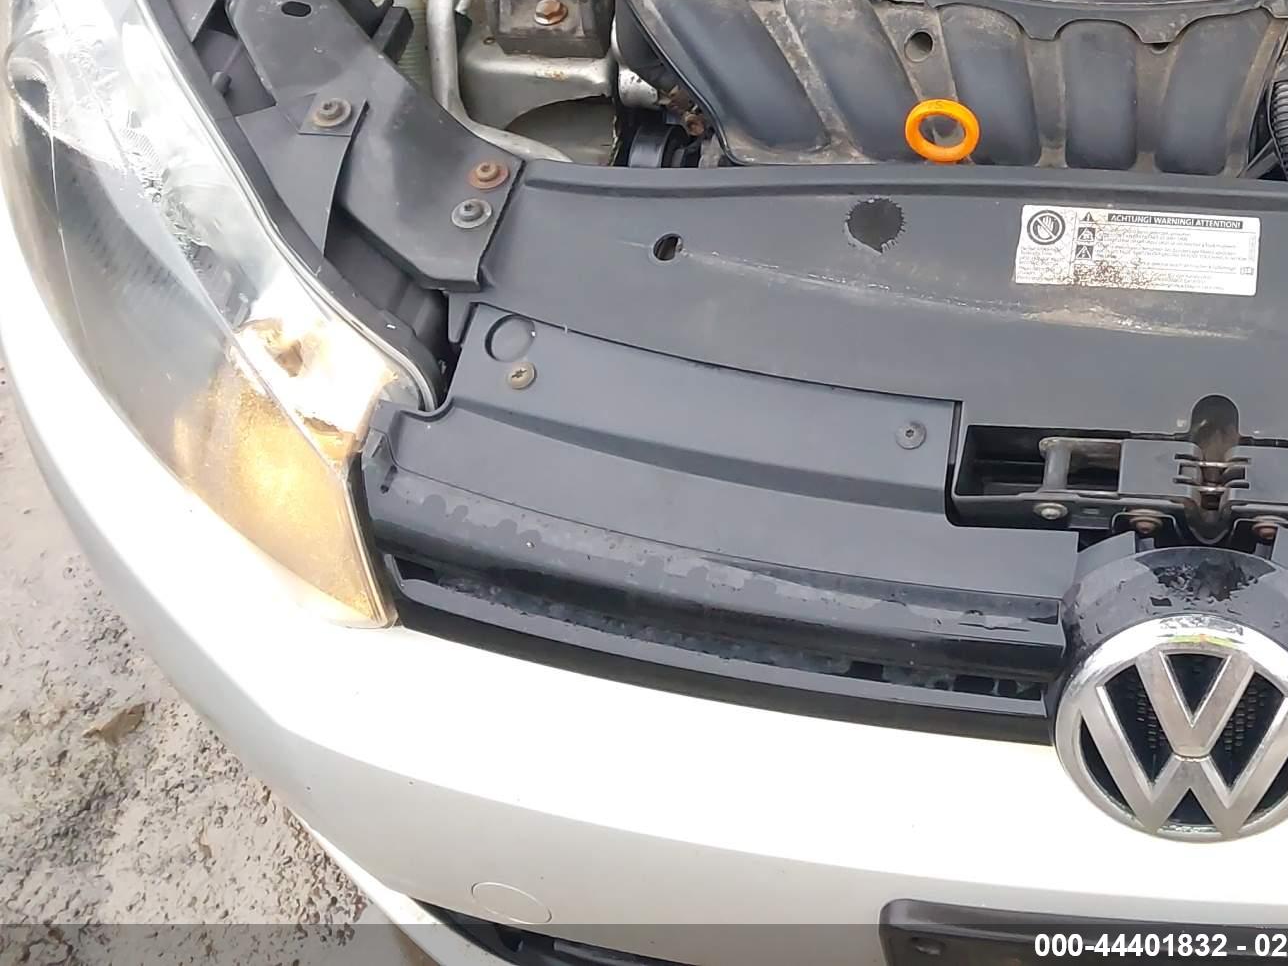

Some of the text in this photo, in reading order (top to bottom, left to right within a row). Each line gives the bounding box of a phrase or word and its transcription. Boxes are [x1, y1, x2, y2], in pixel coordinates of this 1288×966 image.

[1110, 214, 1241, 229] ACHTUNG! WARNING! ATTENTION!
